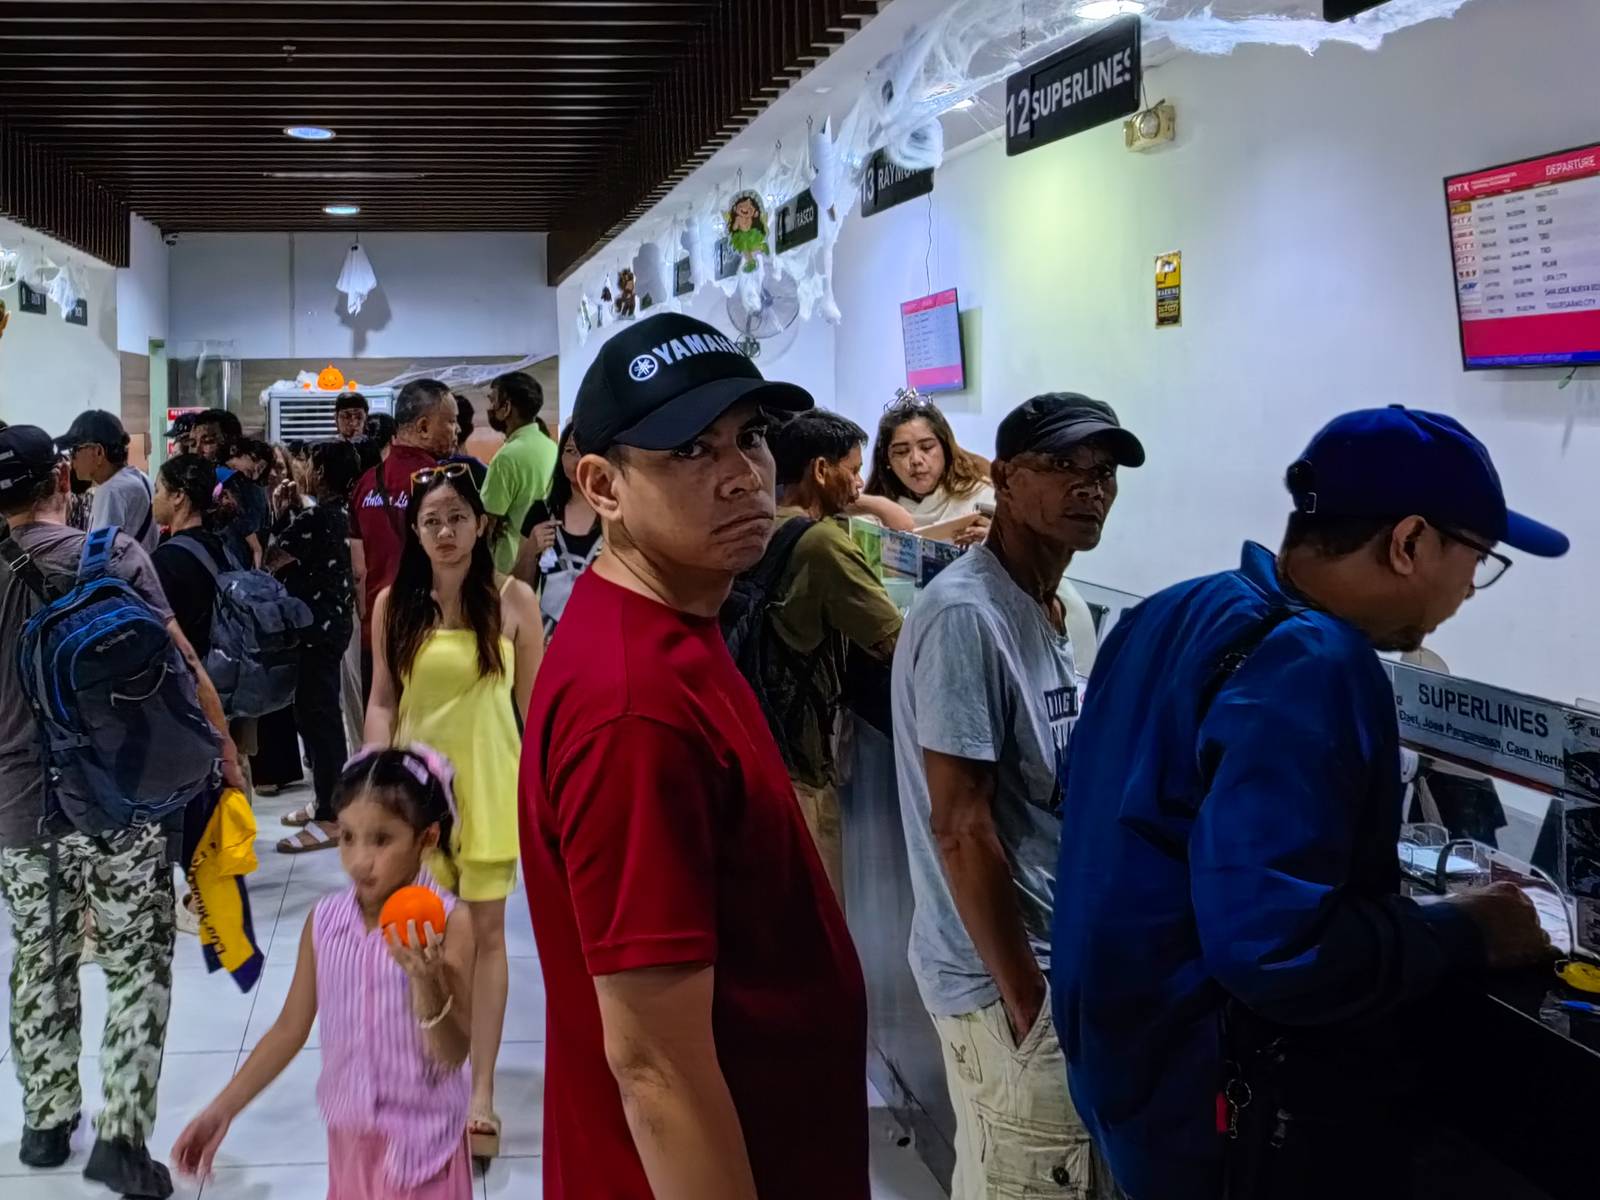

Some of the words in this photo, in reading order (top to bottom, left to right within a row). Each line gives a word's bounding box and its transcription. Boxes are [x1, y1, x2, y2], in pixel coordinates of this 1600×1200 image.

[1006, 88, 1030, 137] 12
[1031, 47, 1131, 120] SUPERLINES
[860, 167, 875, 204] 13
[1545, 155, 1596, 176] DEPARTURE
[1418, 682, 1549, 738] SUPERLINES
